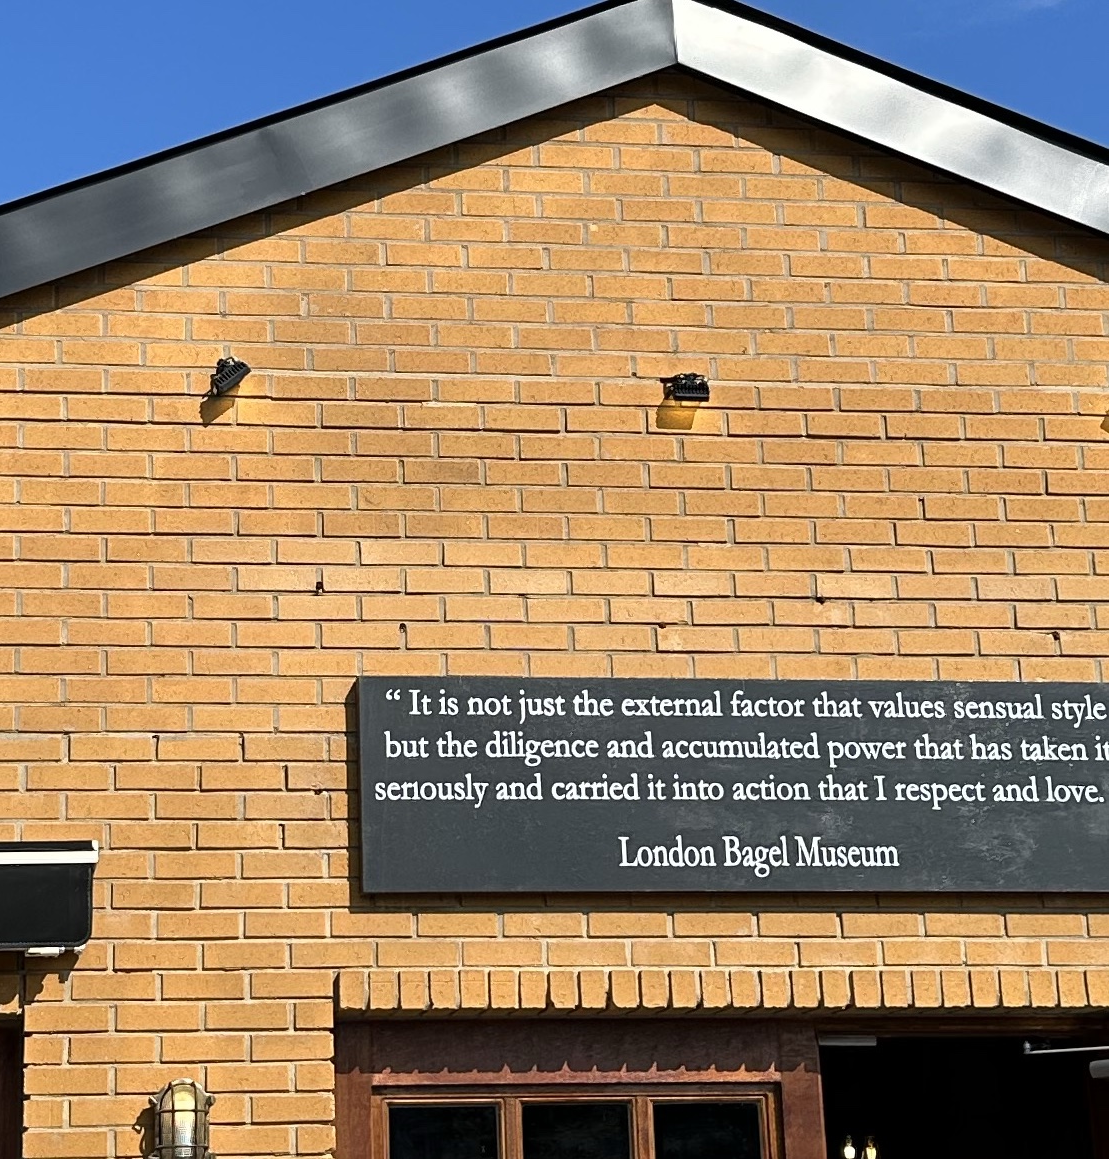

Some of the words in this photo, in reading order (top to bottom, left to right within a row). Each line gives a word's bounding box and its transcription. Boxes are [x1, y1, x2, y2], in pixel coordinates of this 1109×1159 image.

[408, 689, 433, 716] It
[438, 688, 459, 716] is
[466, 694, 513, 716] not
[518, 688, 567, 725] just
[572, 689, 615, 717] the
[621, 690, 724, 717] external
[729, 689, 806, 718] factor
[811, 690, 864, 718] that
[867, 692, 948, 719] values
[953, 692, 1045, 720] sensual
[1050, 693, 1108, 729] style
[384, 730, 430, 759] but
[435, 730, 478, 758] the
[484, 730, 600, 767] diligence
[606, 730, 655, 759] and
[661, 731, 822, 760] accumulated
[827, 740, 907, 769] power
[913, 733, 965, 760] that
[969, 733, 1013, 761] has
[1020, 735, 1090, 762] taken
[374, 772, 490, 809] seriously
[495, 772, 544, 801] and
[551, 772, 641, 801] carried
[646, 773, 667, 801] it
[671, 773, 725, 801] into
[732, 774, 812, 801] action
[817, 773, 869, 801] that
[874, 775, 888, 801] I
[894, 781, 987, 811] respect
[991, 775, 1040, 803] and
[1044, 775, 1105, 803] love.
[617, 835, 717, 868] London
[722, 836, 790, 878] Bagel
[794, 835, 900, 868] Museum
